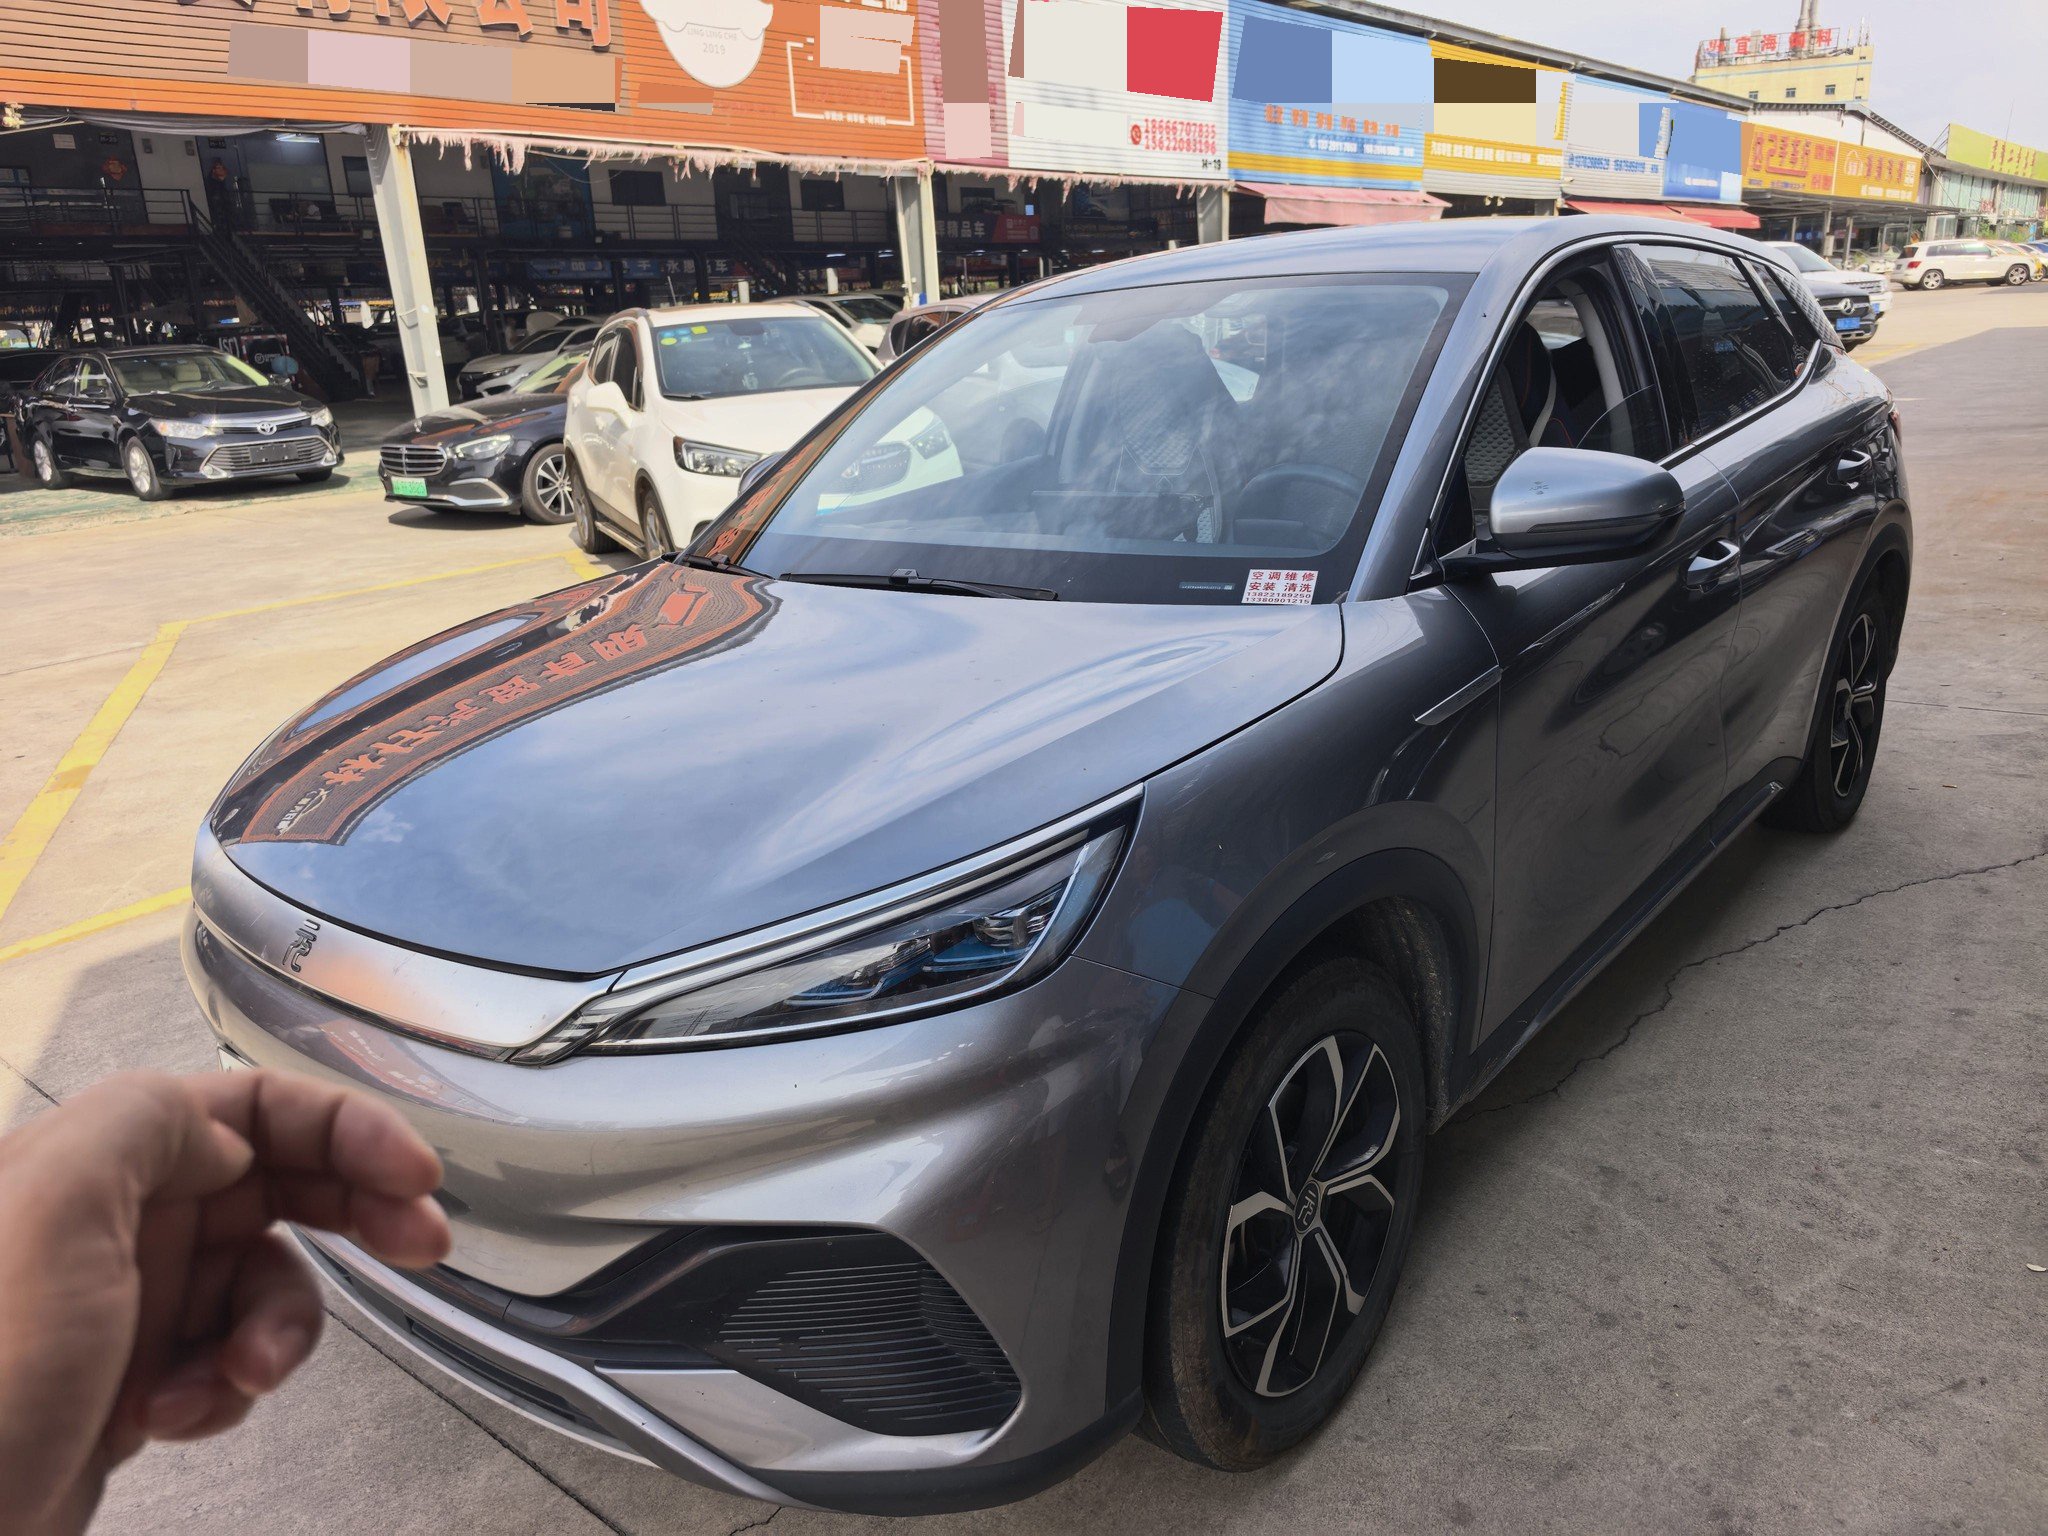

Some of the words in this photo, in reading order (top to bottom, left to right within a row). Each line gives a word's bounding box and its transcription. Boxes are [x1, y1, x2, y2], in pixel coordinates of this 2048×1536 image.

[703, 42, 726, 55] 2019
[1251, 571, 1315, 581] 空调维修
[1249, 582, 1276, 591] 安装
[1284, 582, 1312, 592] 清洗
